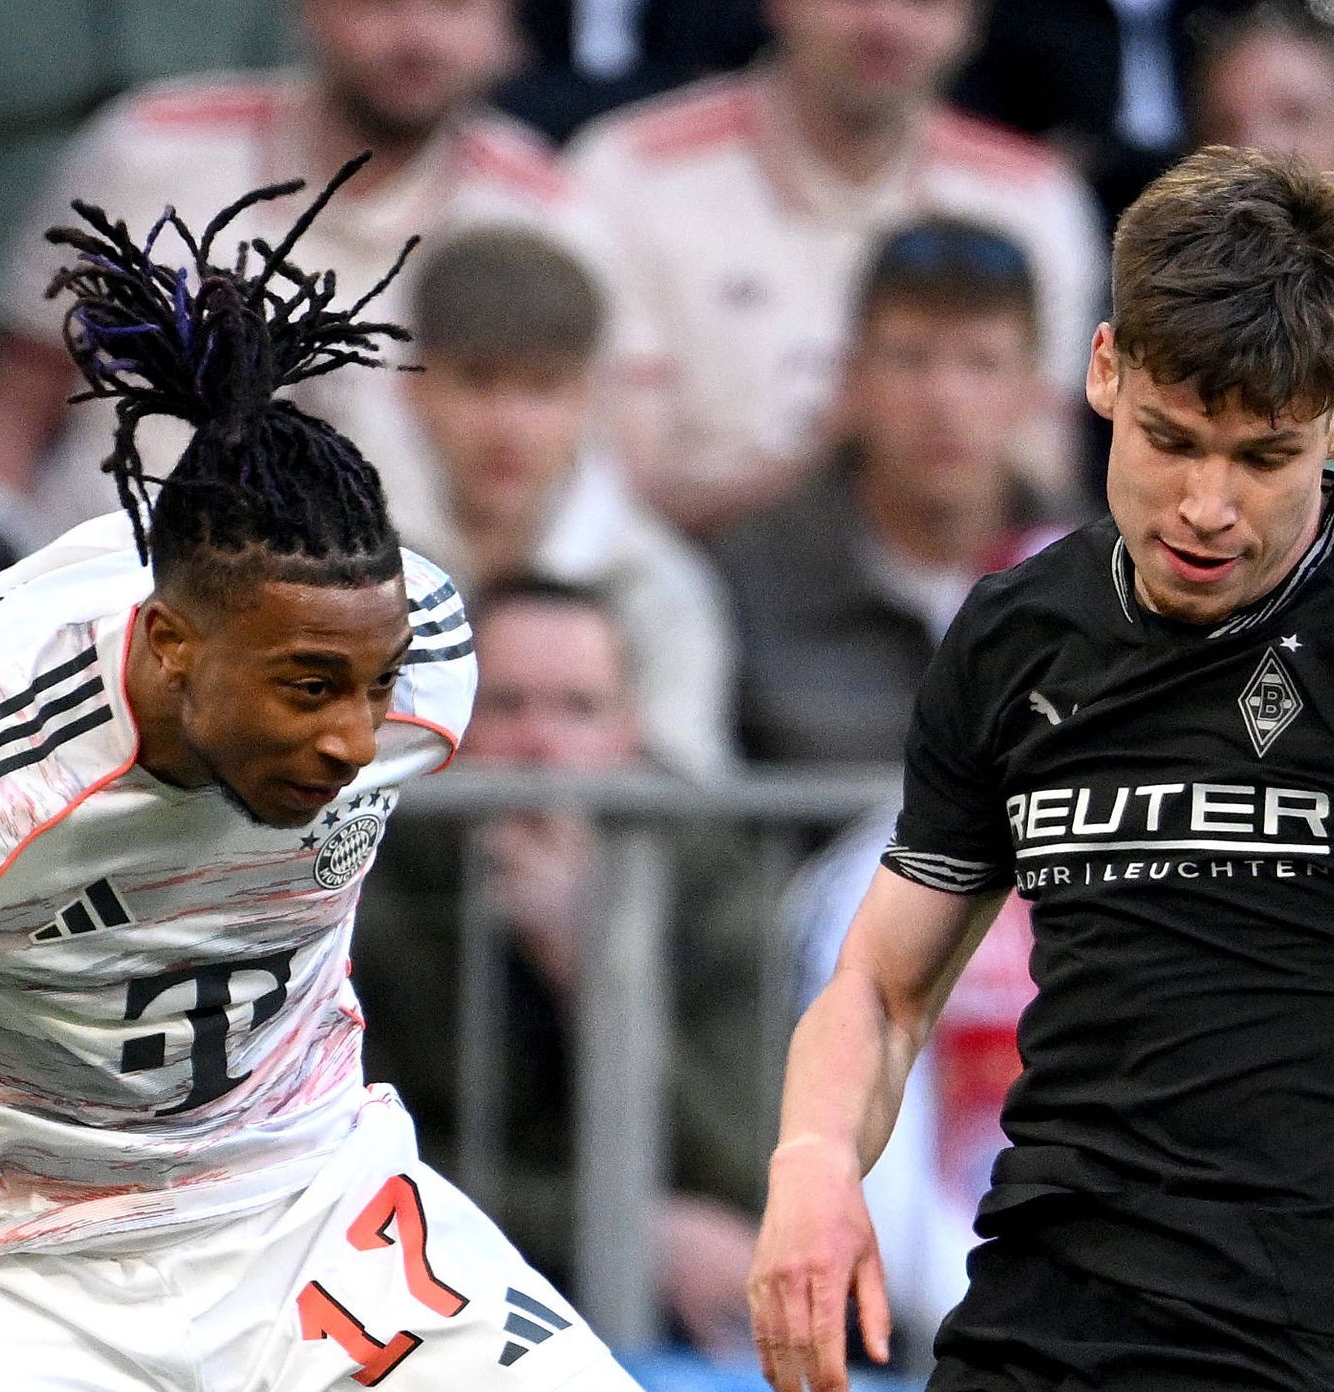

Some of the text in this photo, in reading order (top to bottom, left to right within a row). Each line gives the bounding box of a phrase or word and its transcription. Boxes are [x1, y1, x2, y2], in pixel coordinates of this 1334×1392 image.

[1258, 683, 1286, 721] B
[1006, 783, 1330, 841] REUTER
[296, 1173, 470, 1387] 17
